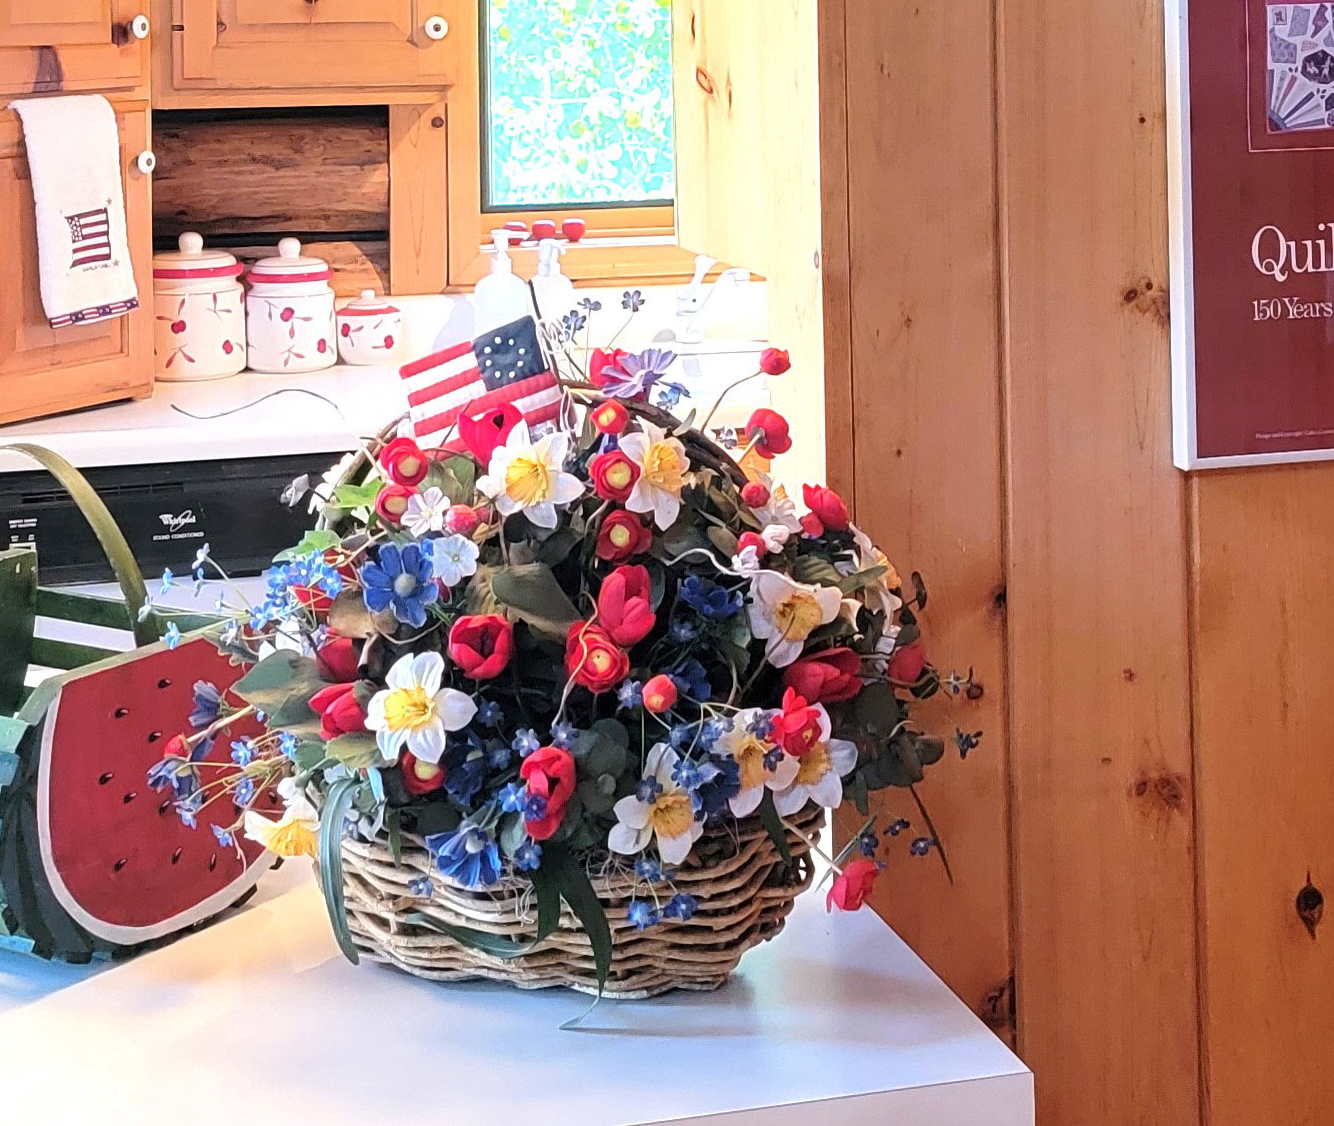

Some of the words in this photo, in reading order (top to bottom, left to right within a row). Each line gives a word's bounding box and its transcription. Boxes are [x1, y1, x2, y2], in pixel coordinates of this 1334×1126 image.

[1251, 298, 1281, 321] 150
[1282, 295, 1333, 319] Years
[158, 510, 196, 532] Whirlpool
